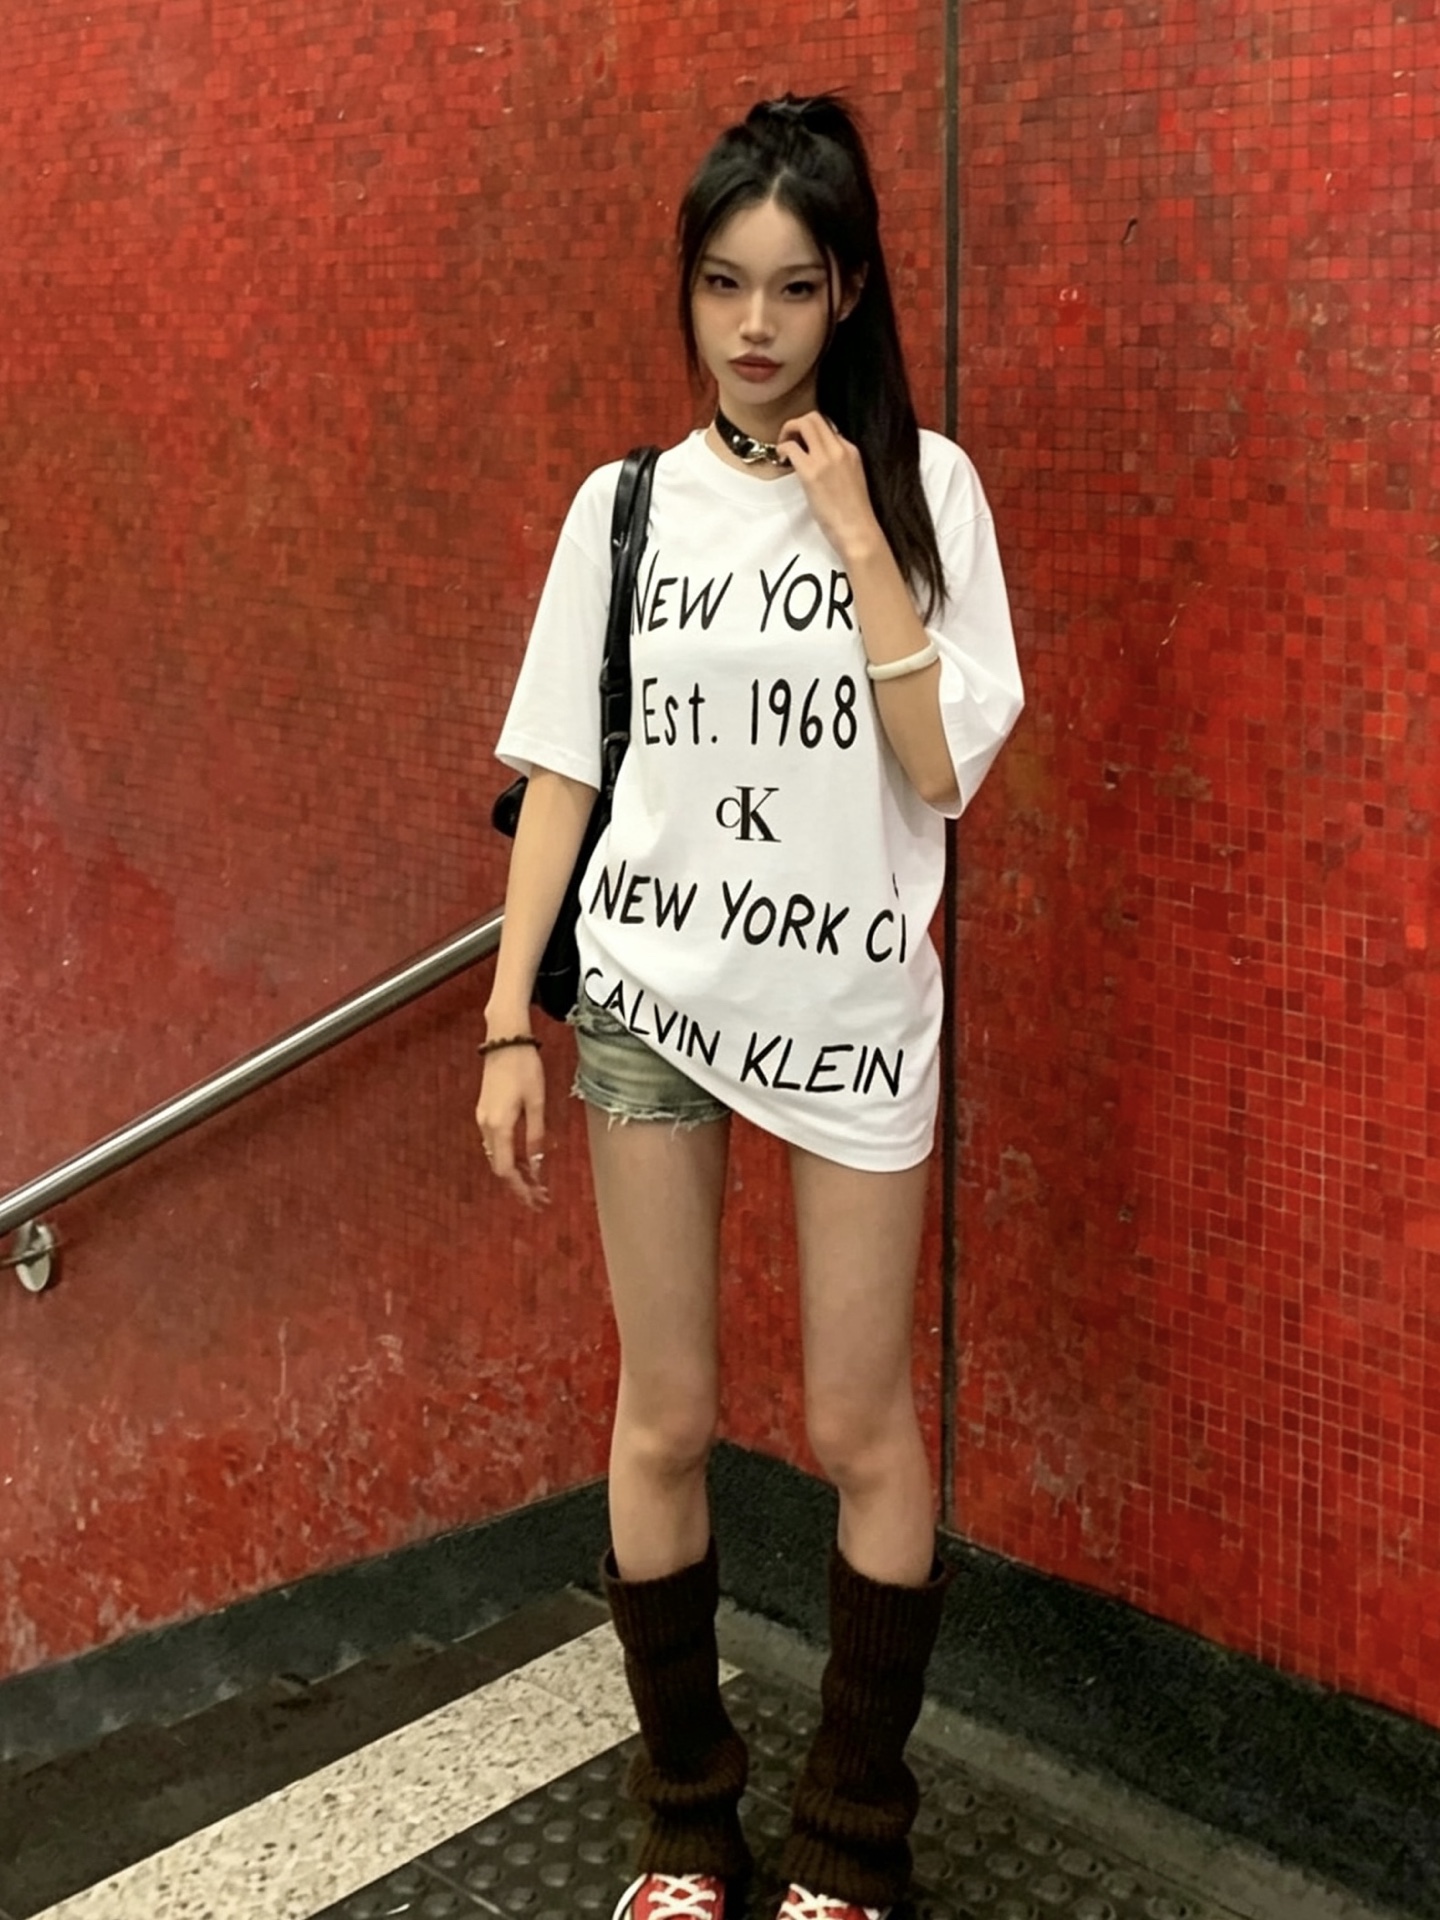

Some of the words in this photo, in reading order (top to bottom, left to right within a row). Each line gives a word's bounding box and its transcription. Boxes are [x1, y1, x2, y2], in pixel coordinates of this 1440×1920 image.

[632, 549, 733, 636] NEW
[760, 553, 862, 633] YOR
[642, 677, 718, 745] Est.
[751, 675, 857, 749] 1968
[588, 859, 698, 932] NEW
[720, 878, 850, 956] YORK
[584, 967, 721, 1066] CALVIN
[740, 1031, 904, 1097] KLEIN
